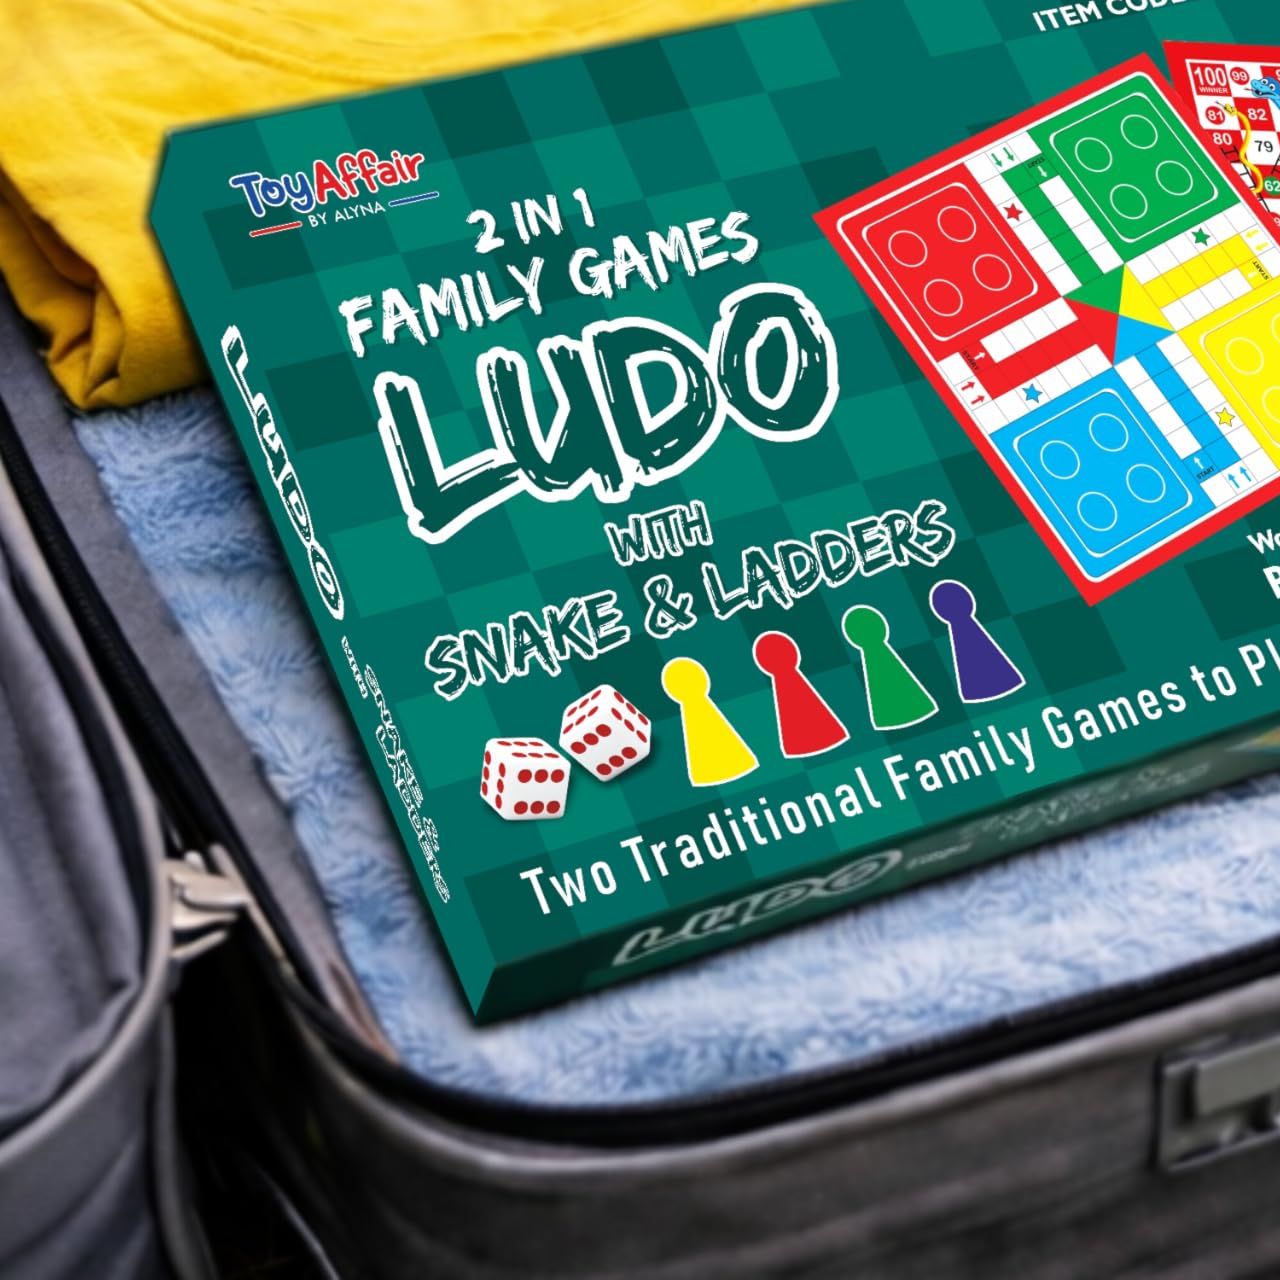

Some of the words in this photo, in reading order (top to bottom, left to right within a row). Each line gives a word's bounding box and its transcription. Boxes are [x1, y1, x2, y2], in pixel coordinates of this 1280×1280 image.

[1032, 0, 1103, 32] ITEM
[1194, 67, 1227, 86] 100
[1231, 71, 1248, 81] 99
[1208, 110, 1224, 121] 81
[1247, 108, 1267, 121] 82
[1212, 132, 1232, 145] 80
[1254, 140, 1274, 153] 79
[229, 149, 424, 217] ToyAffair
[308, 212, 328, 228] BY
[335, 201, 386, 222] ALYNA
[467, 208, 505, 255] 2
[513, 196, 564, 246] IN
[573, 188, 597, 228] 1
[339, 256, 546, 359] FAMILY
[569, 211, 760, 299] GAMES
[1252, 260, 1269, 280] START
[373, 282, 840, 545] LUDO
[605, 501, 713, 566] WITH
[425, 590, 631, 701] SNAKE
[645, 575, 697, 638] &
[701, 500, 957, 620] LADDERS
[519, 861, 617, 915] Two
[620, 767, 882, 882] Traditional
[884, 725, 1035, 801] Family
[1041, 683, 1187, 749] Games
[1190, 665, 1237, 702] to
